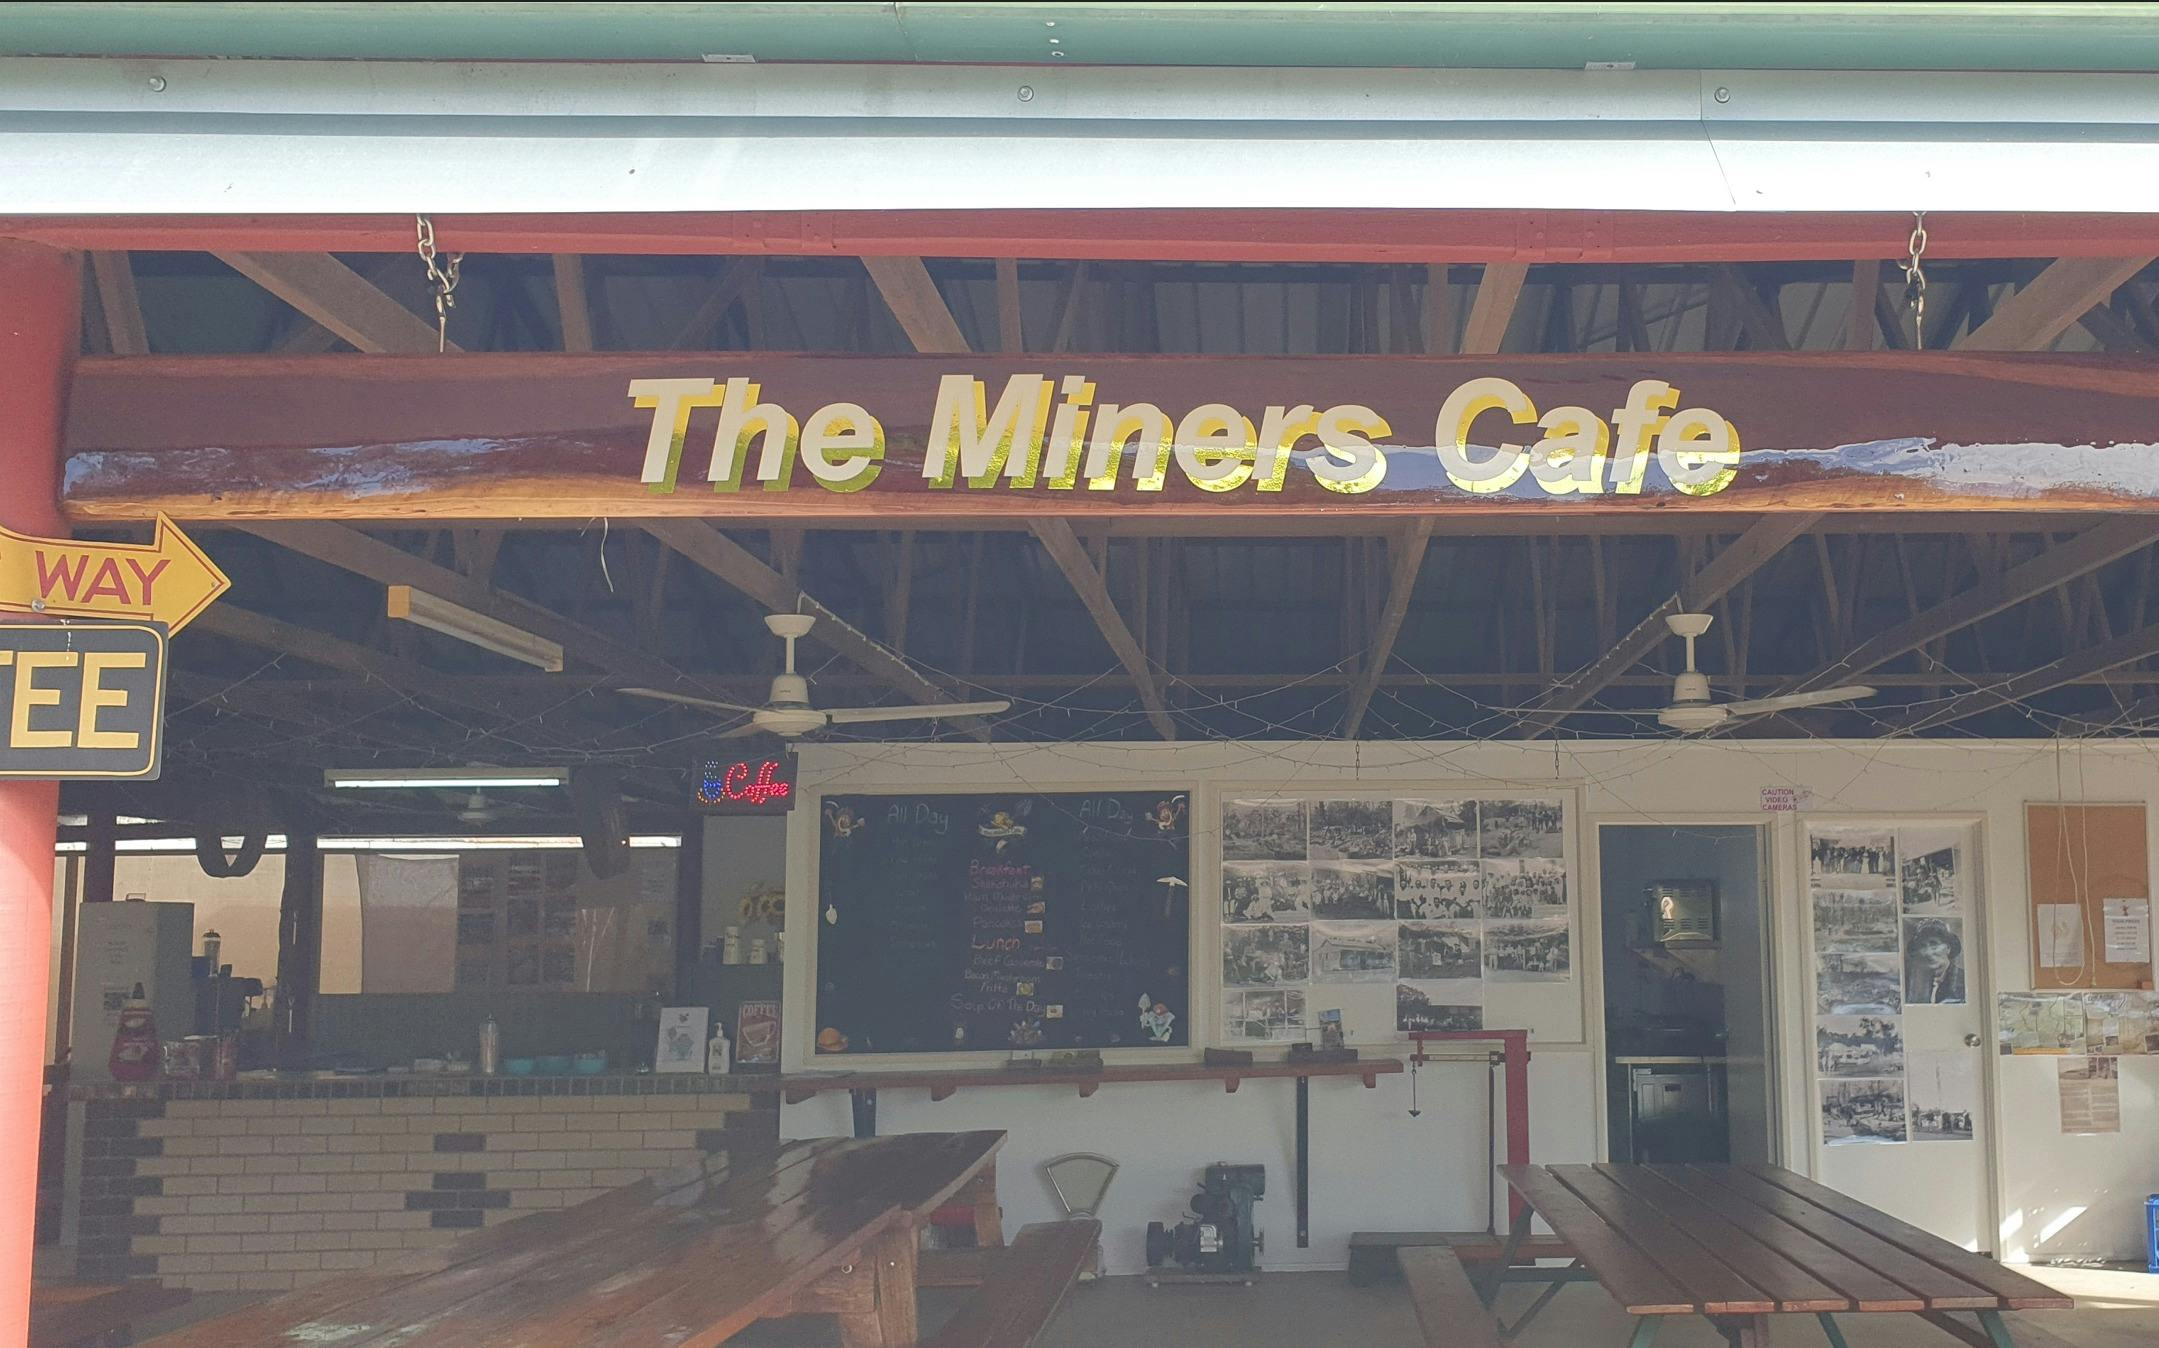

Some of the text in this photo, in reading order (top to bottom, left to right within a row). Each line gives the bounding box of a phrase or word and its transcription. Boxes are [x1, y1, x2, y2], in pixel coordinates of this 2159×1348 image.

[627, 372, 1741, 496] The Miners Cafe
[35, 550, 171, 606] WAY
[0, 650, 147, 749] EE
[1079, 799, 1101, 818] All
[1761, 788, 1794, 796] CAUTION
[887, 802, 950, 836] All Day
[971, 935, 1021, 951] Lunch
